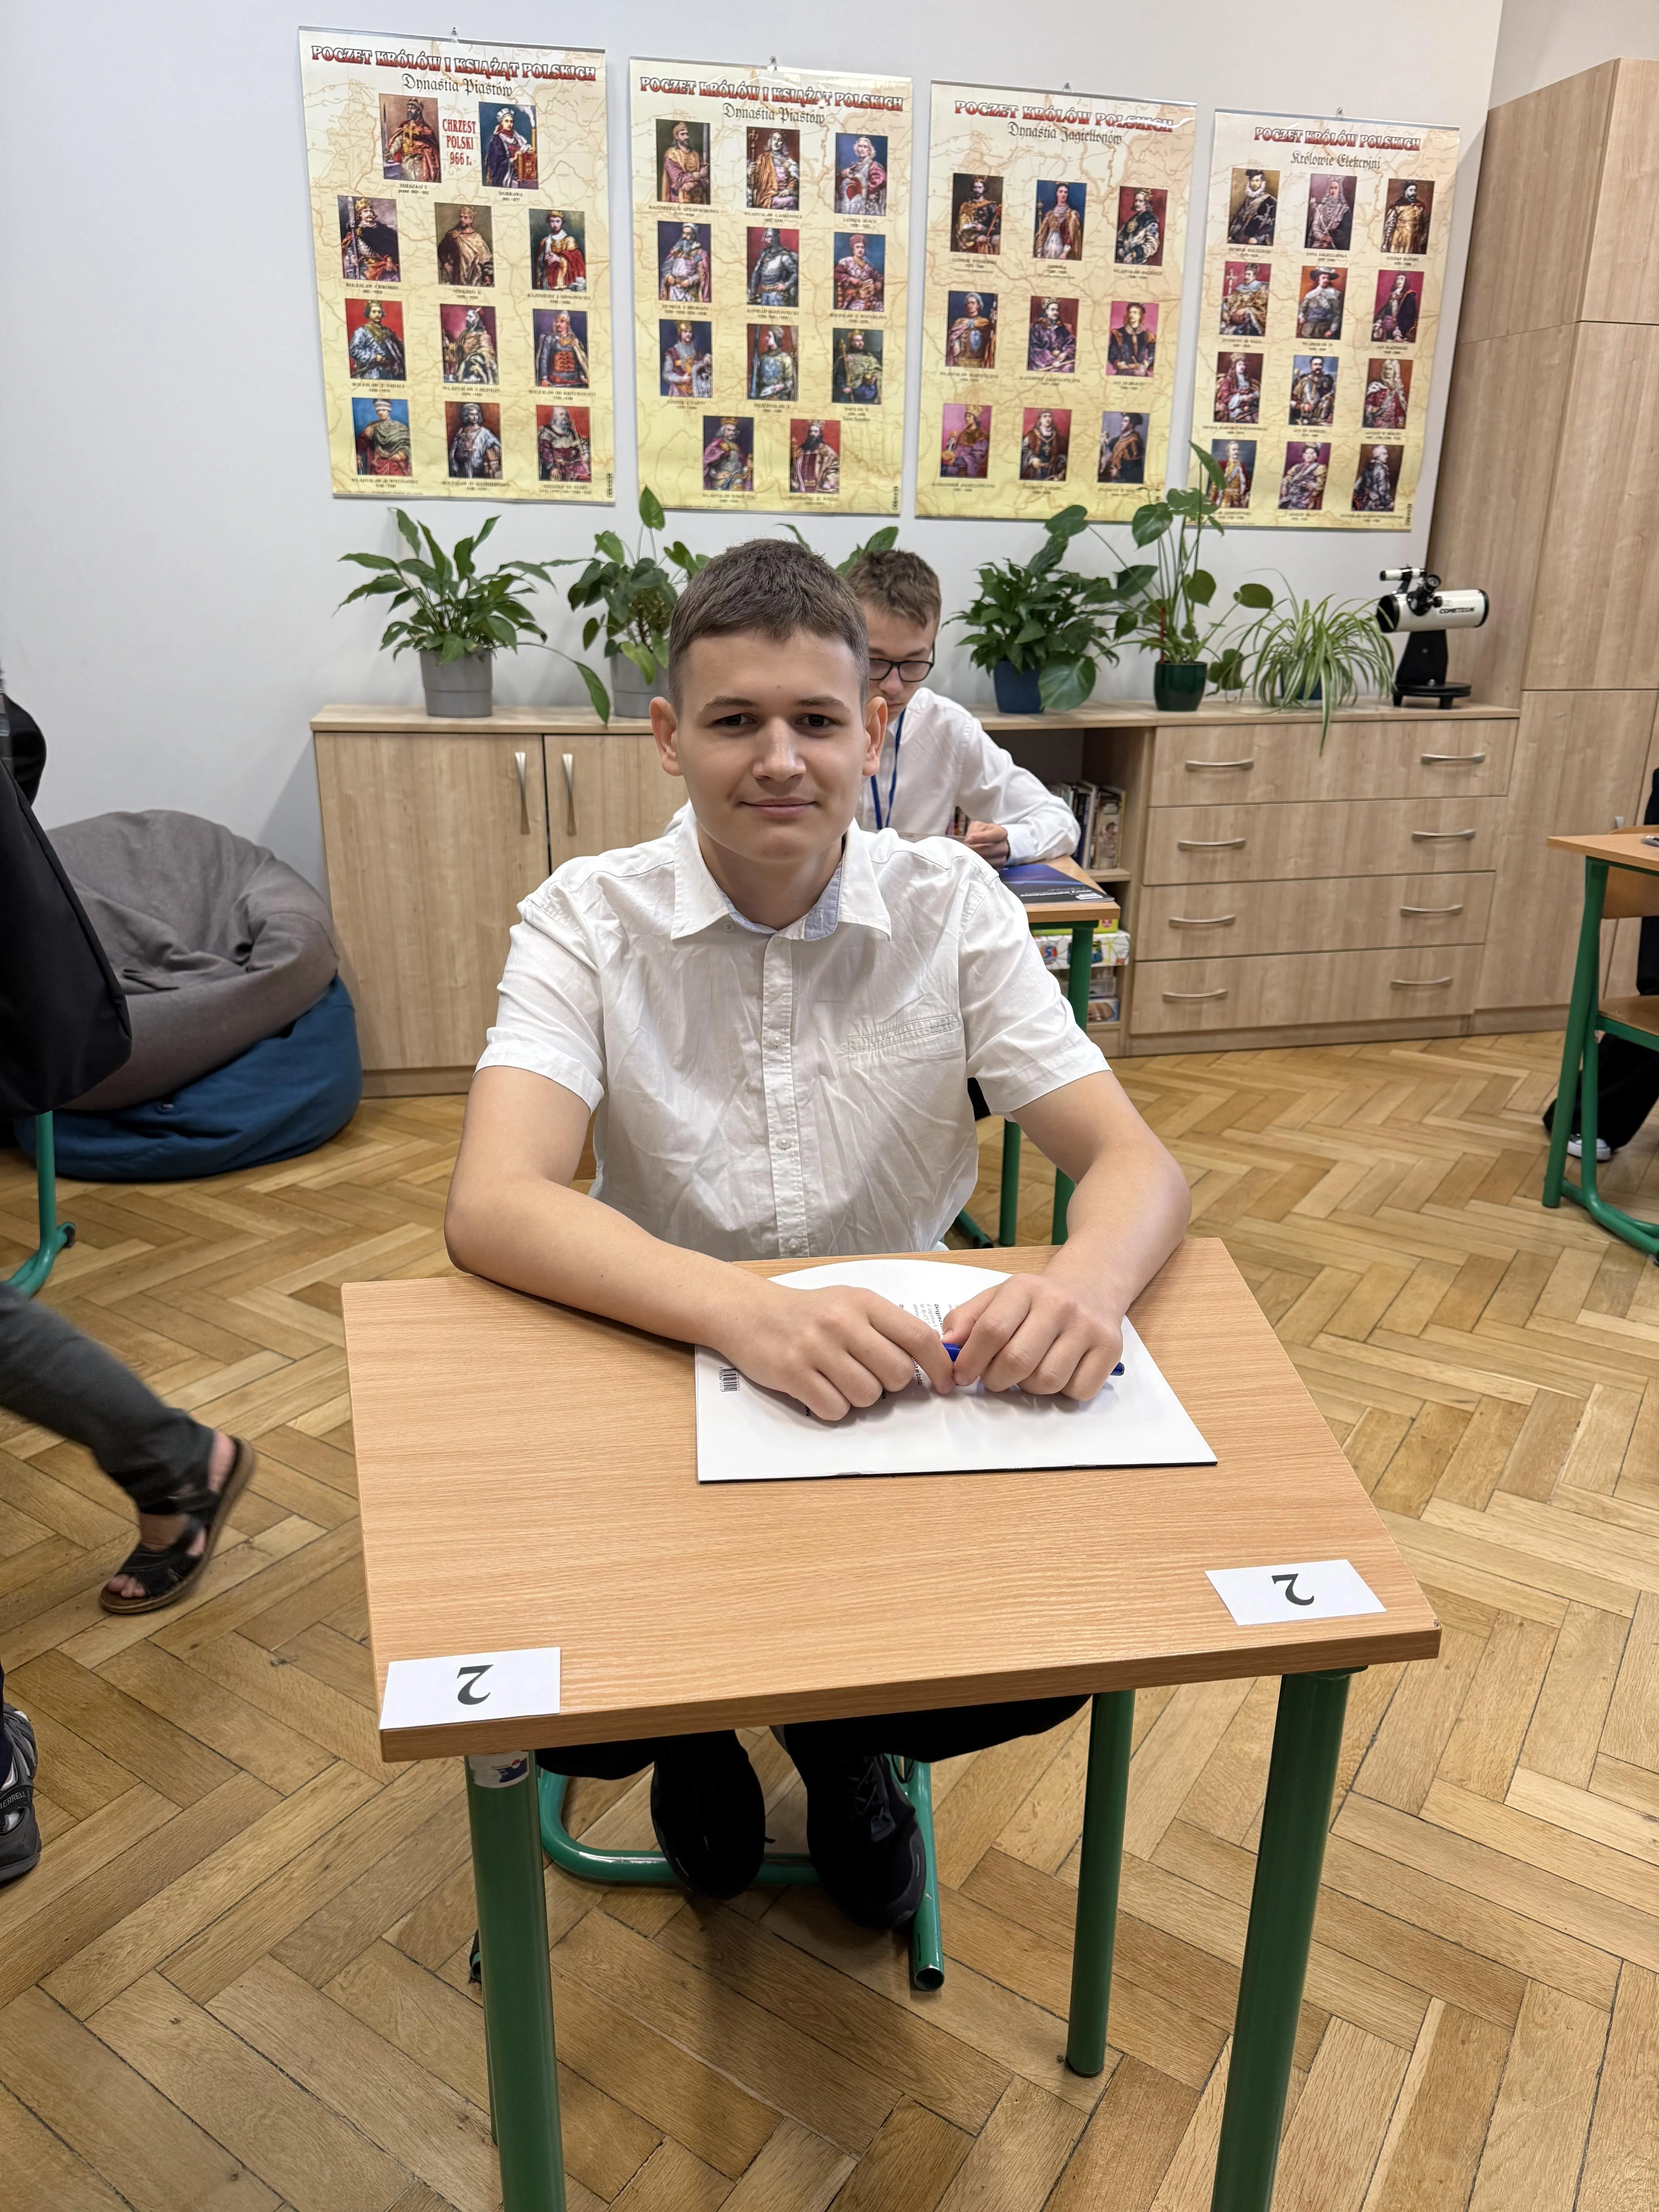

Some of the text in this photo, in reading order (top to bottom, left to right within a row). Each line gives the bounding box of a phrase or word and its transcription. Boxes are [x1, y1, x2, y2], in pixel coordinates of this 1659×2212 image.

[312, 46, 596, 81] POCZET KRÓLÓW I KSIĄŻĄT POLSKICH
[402, 74, 513, 96] Dynastia Piastów
[640, 77, 903, 111] POCZET KRÓLÓW I KSIĄŻĄT POLSKICH
[723, 103, 826, 124] Dynastia Piastów
[955, 100, 1173, 132] POCZET KRÓLÓW POLSKICH
[442, 118, 476, 134] CHRZEST
[1008, 121, 1122, 144] Dynastia Jagiellonów
[447, 135, 474, 150] POLSKI
[1254, 127, 1421, 151] POCZET KRÓLÓW POLSKICH
[450, 152, 472, 166] 966 r.
[1291, 150, 1382, 170] Królowie Elekcyjni
[1271, 1573, 1314, 1606] 2
[457, 1664, 494, 1705] 2
